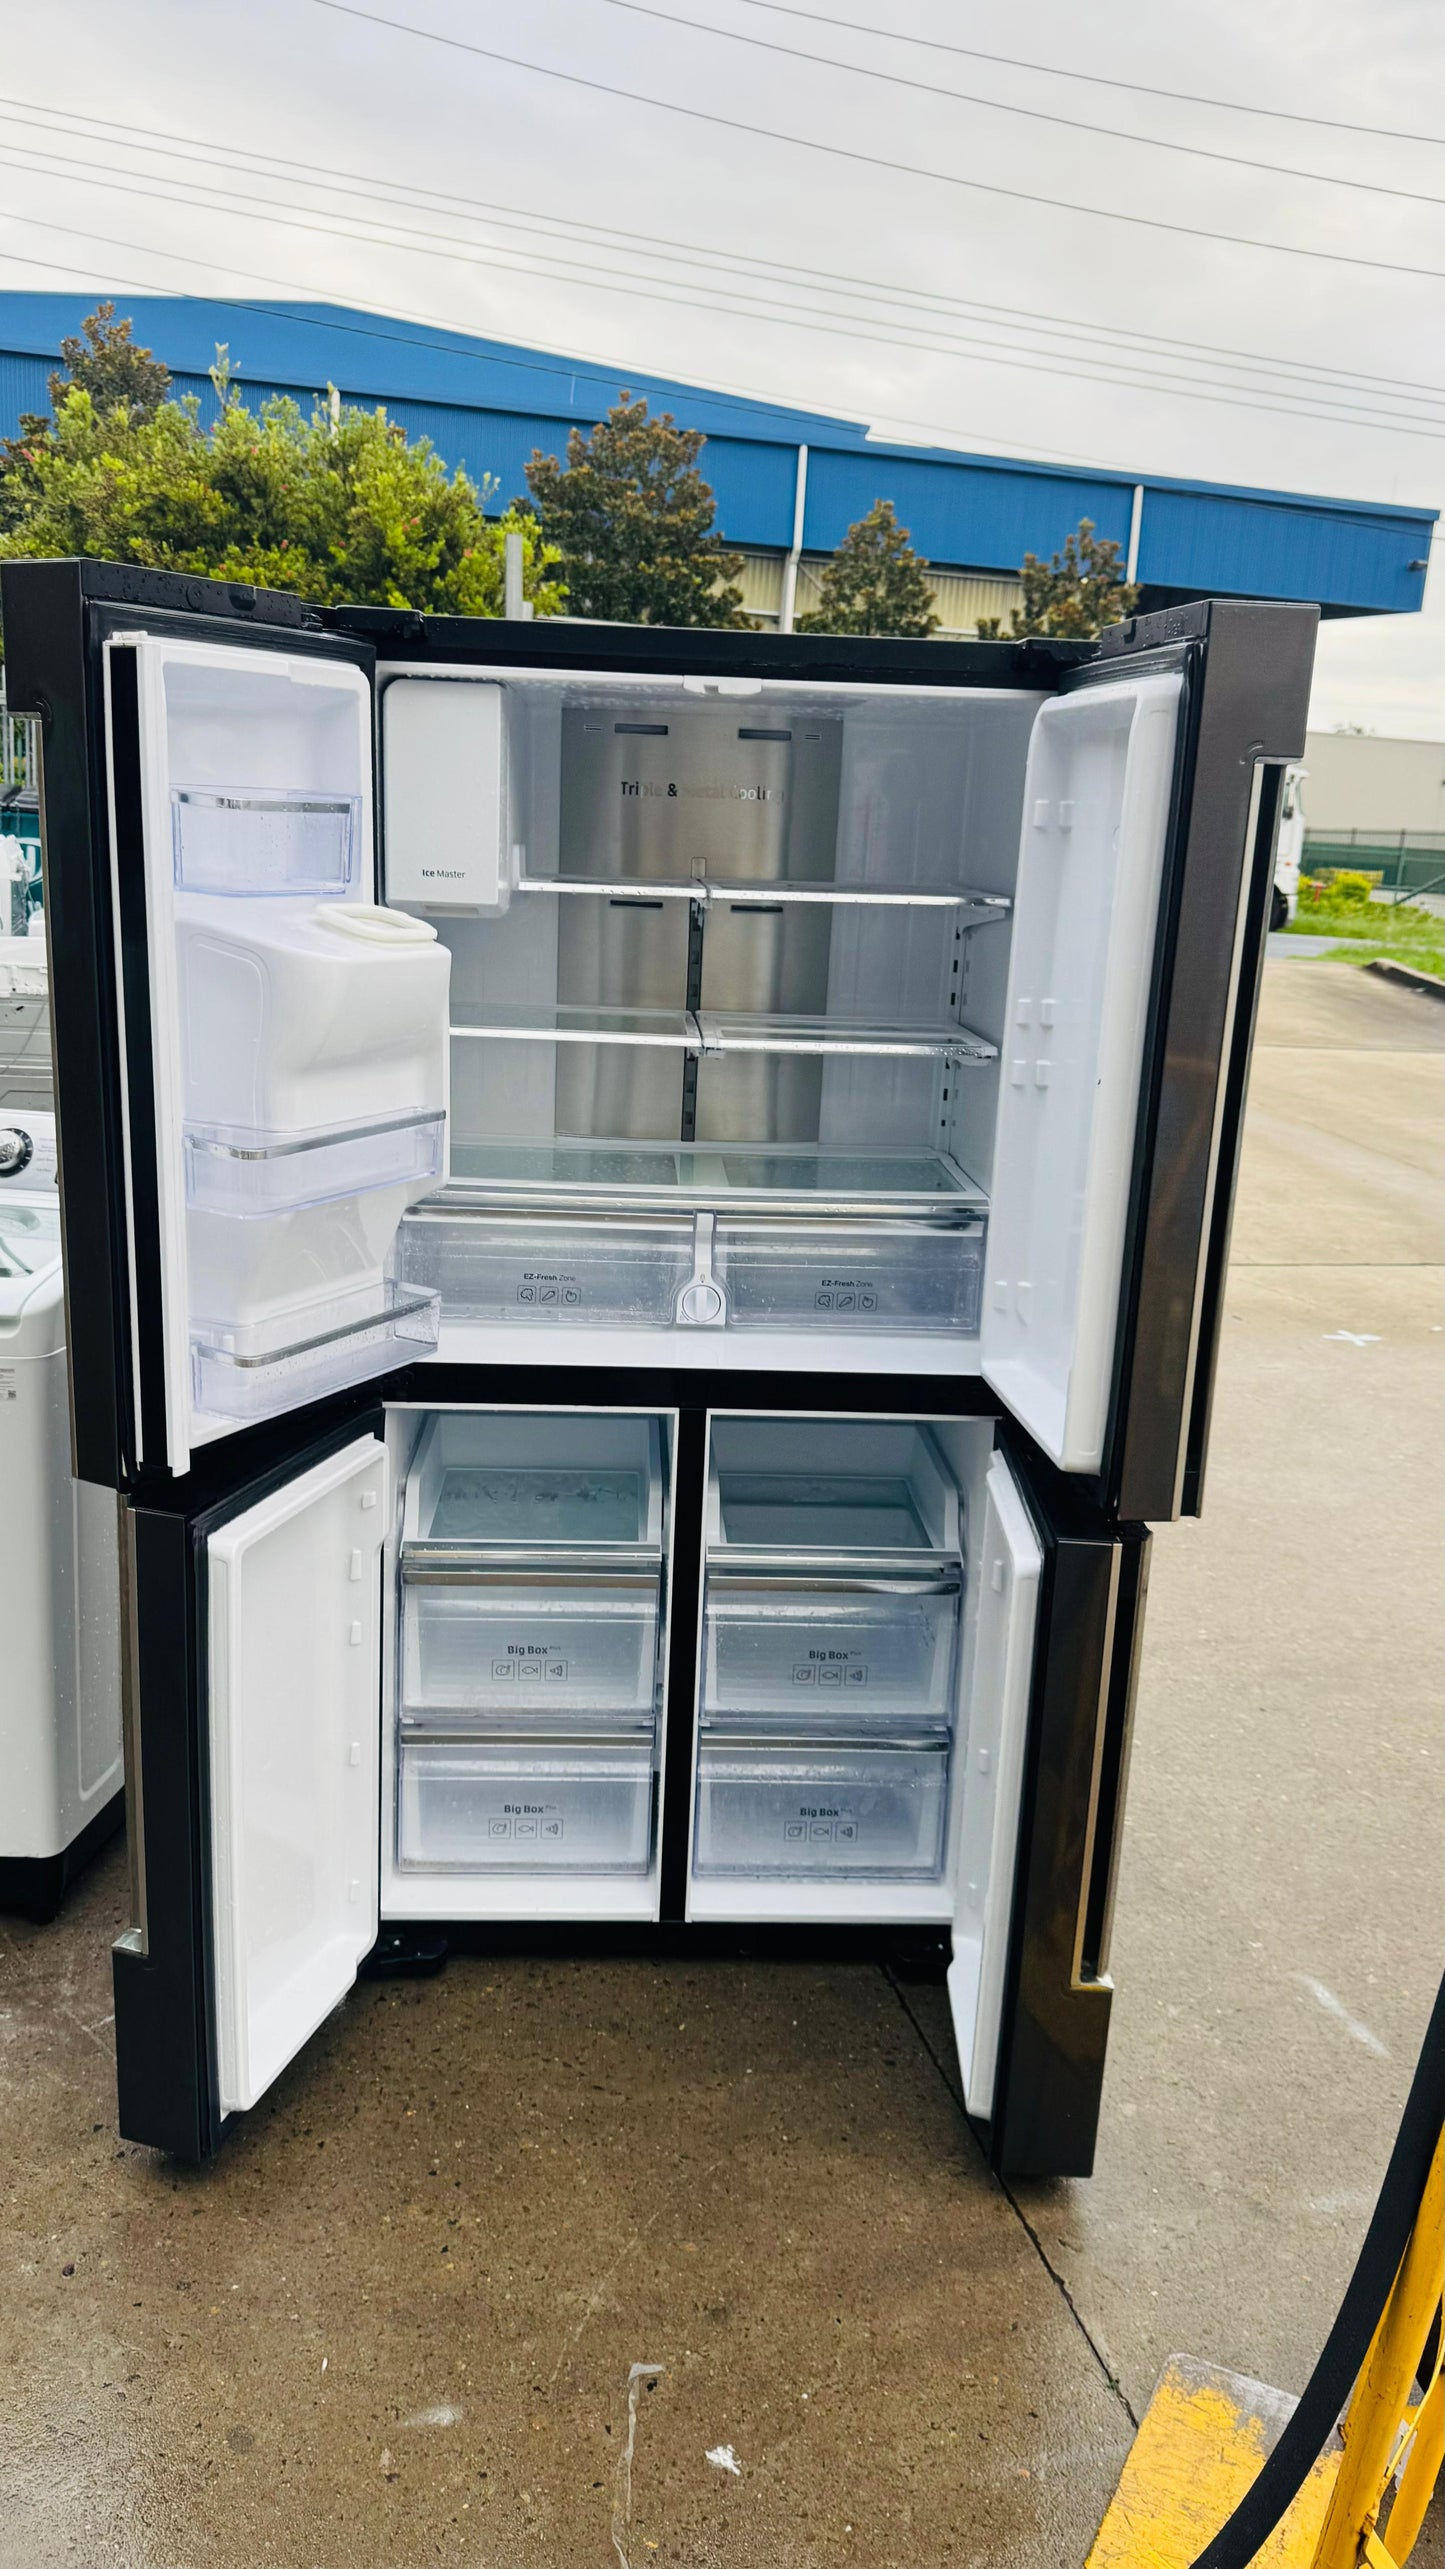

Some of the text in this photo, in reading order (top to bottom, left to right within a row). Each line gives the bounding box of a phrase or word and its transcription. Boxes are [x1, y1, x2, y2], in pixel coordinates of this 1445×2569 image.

[667, 783, 678, 797] &
[422, 868, 466, 879] Ice Master
[523, 1273, 558, 1281] EZ-Fresh
[821, 1280, 855, 1288] EZ-Fresh
[507, 1645, 525, 1656] Big
[527, 1645, 548, 1655] Box
[808, 1650, 826, 1661] Big
[828, 1650, 849, 1660] Box
[504, 1804, 522, 1815] Big
[524, 1804, 544, 1814] Box
[800, 1807, 817, 1818] Big
[819, 1807, 839, 1817] Box
